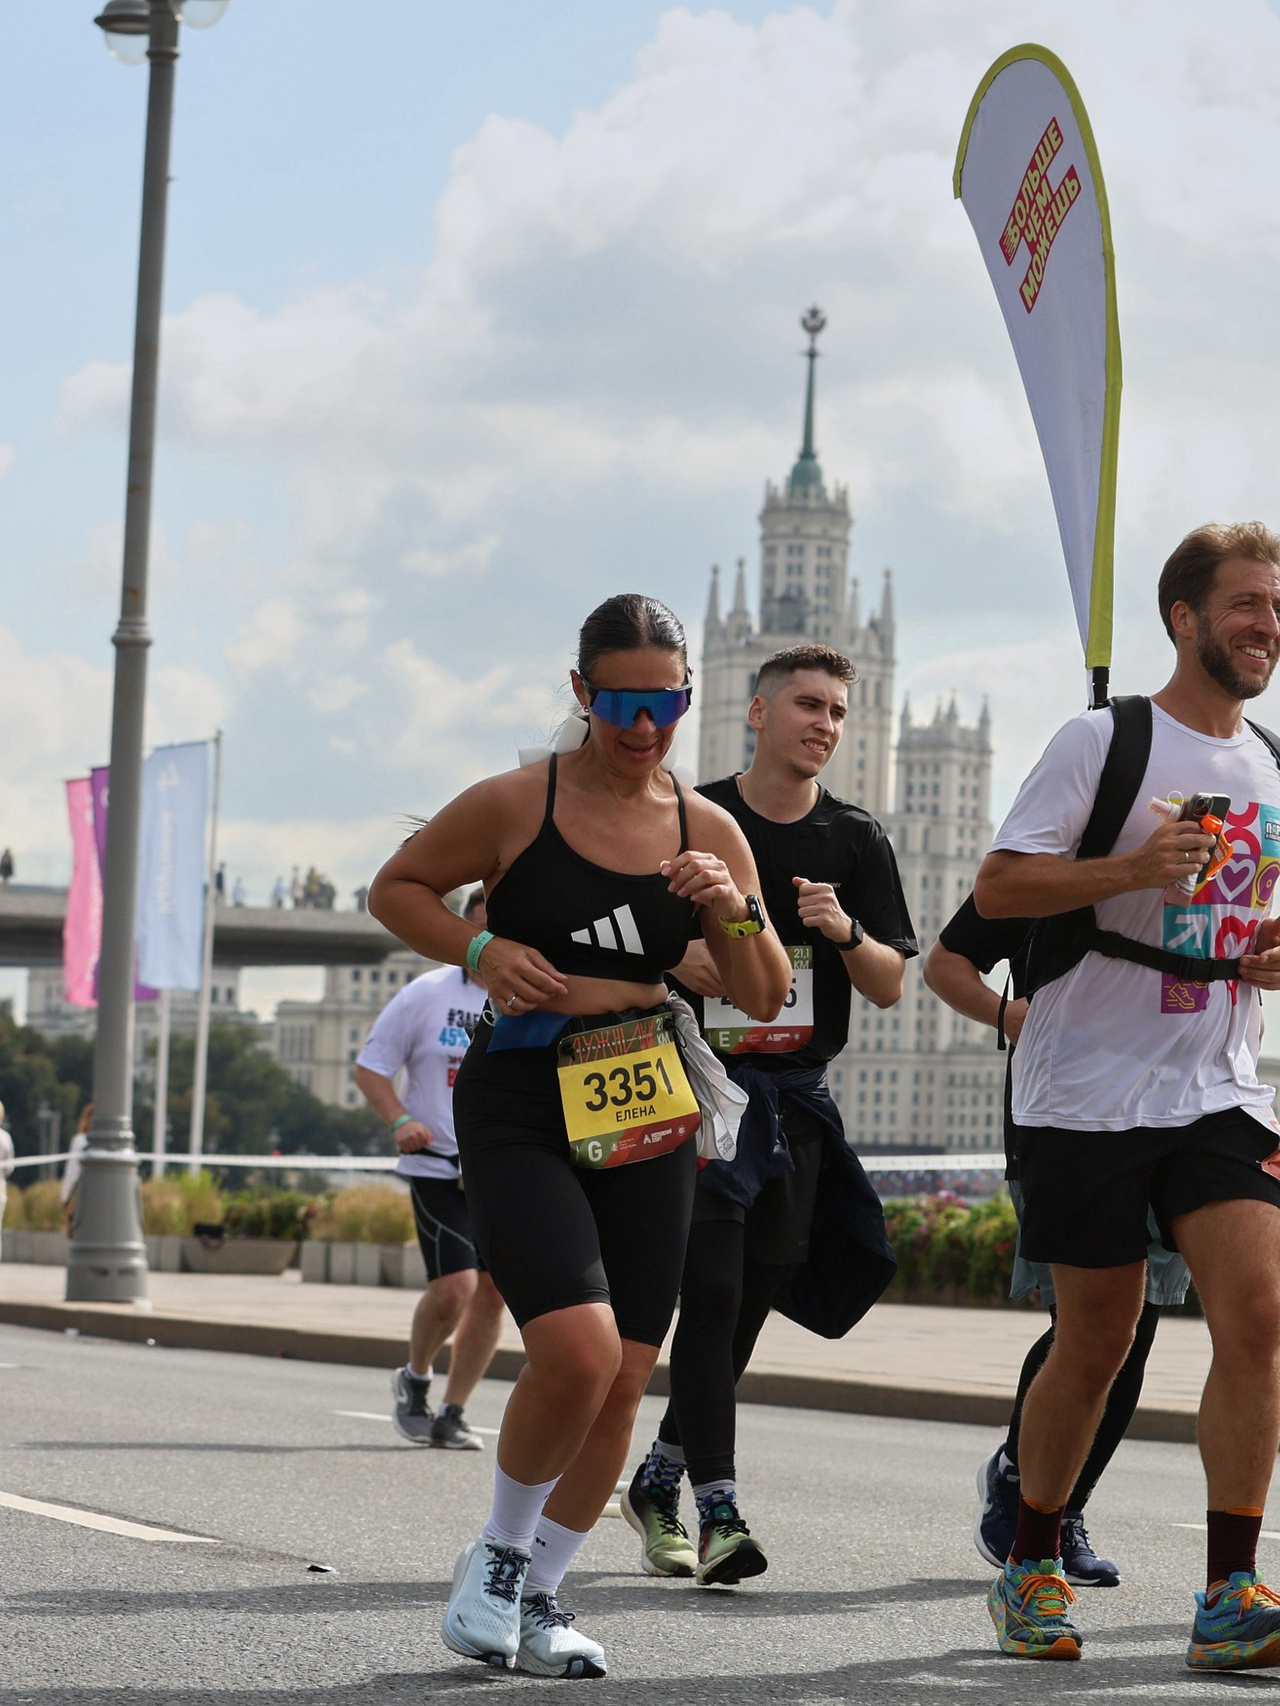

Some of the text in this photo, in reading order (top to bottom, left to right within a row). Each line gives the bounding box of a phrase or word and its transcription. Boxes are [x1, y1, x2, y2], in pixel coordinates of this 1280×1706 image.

[1005, 120, 1062, 245] БОЛЬШЕ
[1024, 177, 1052, 243] ЧЕМ
[1021, 176, 1079, 309] МОЖЕШЬ
[719, 1031, 730, 1048] E
[583, 1057, 674, 1112] 3351
[615, 1105, 656, 1123] ЕЛЕНА
[587, 1140, 603, 1162] G
